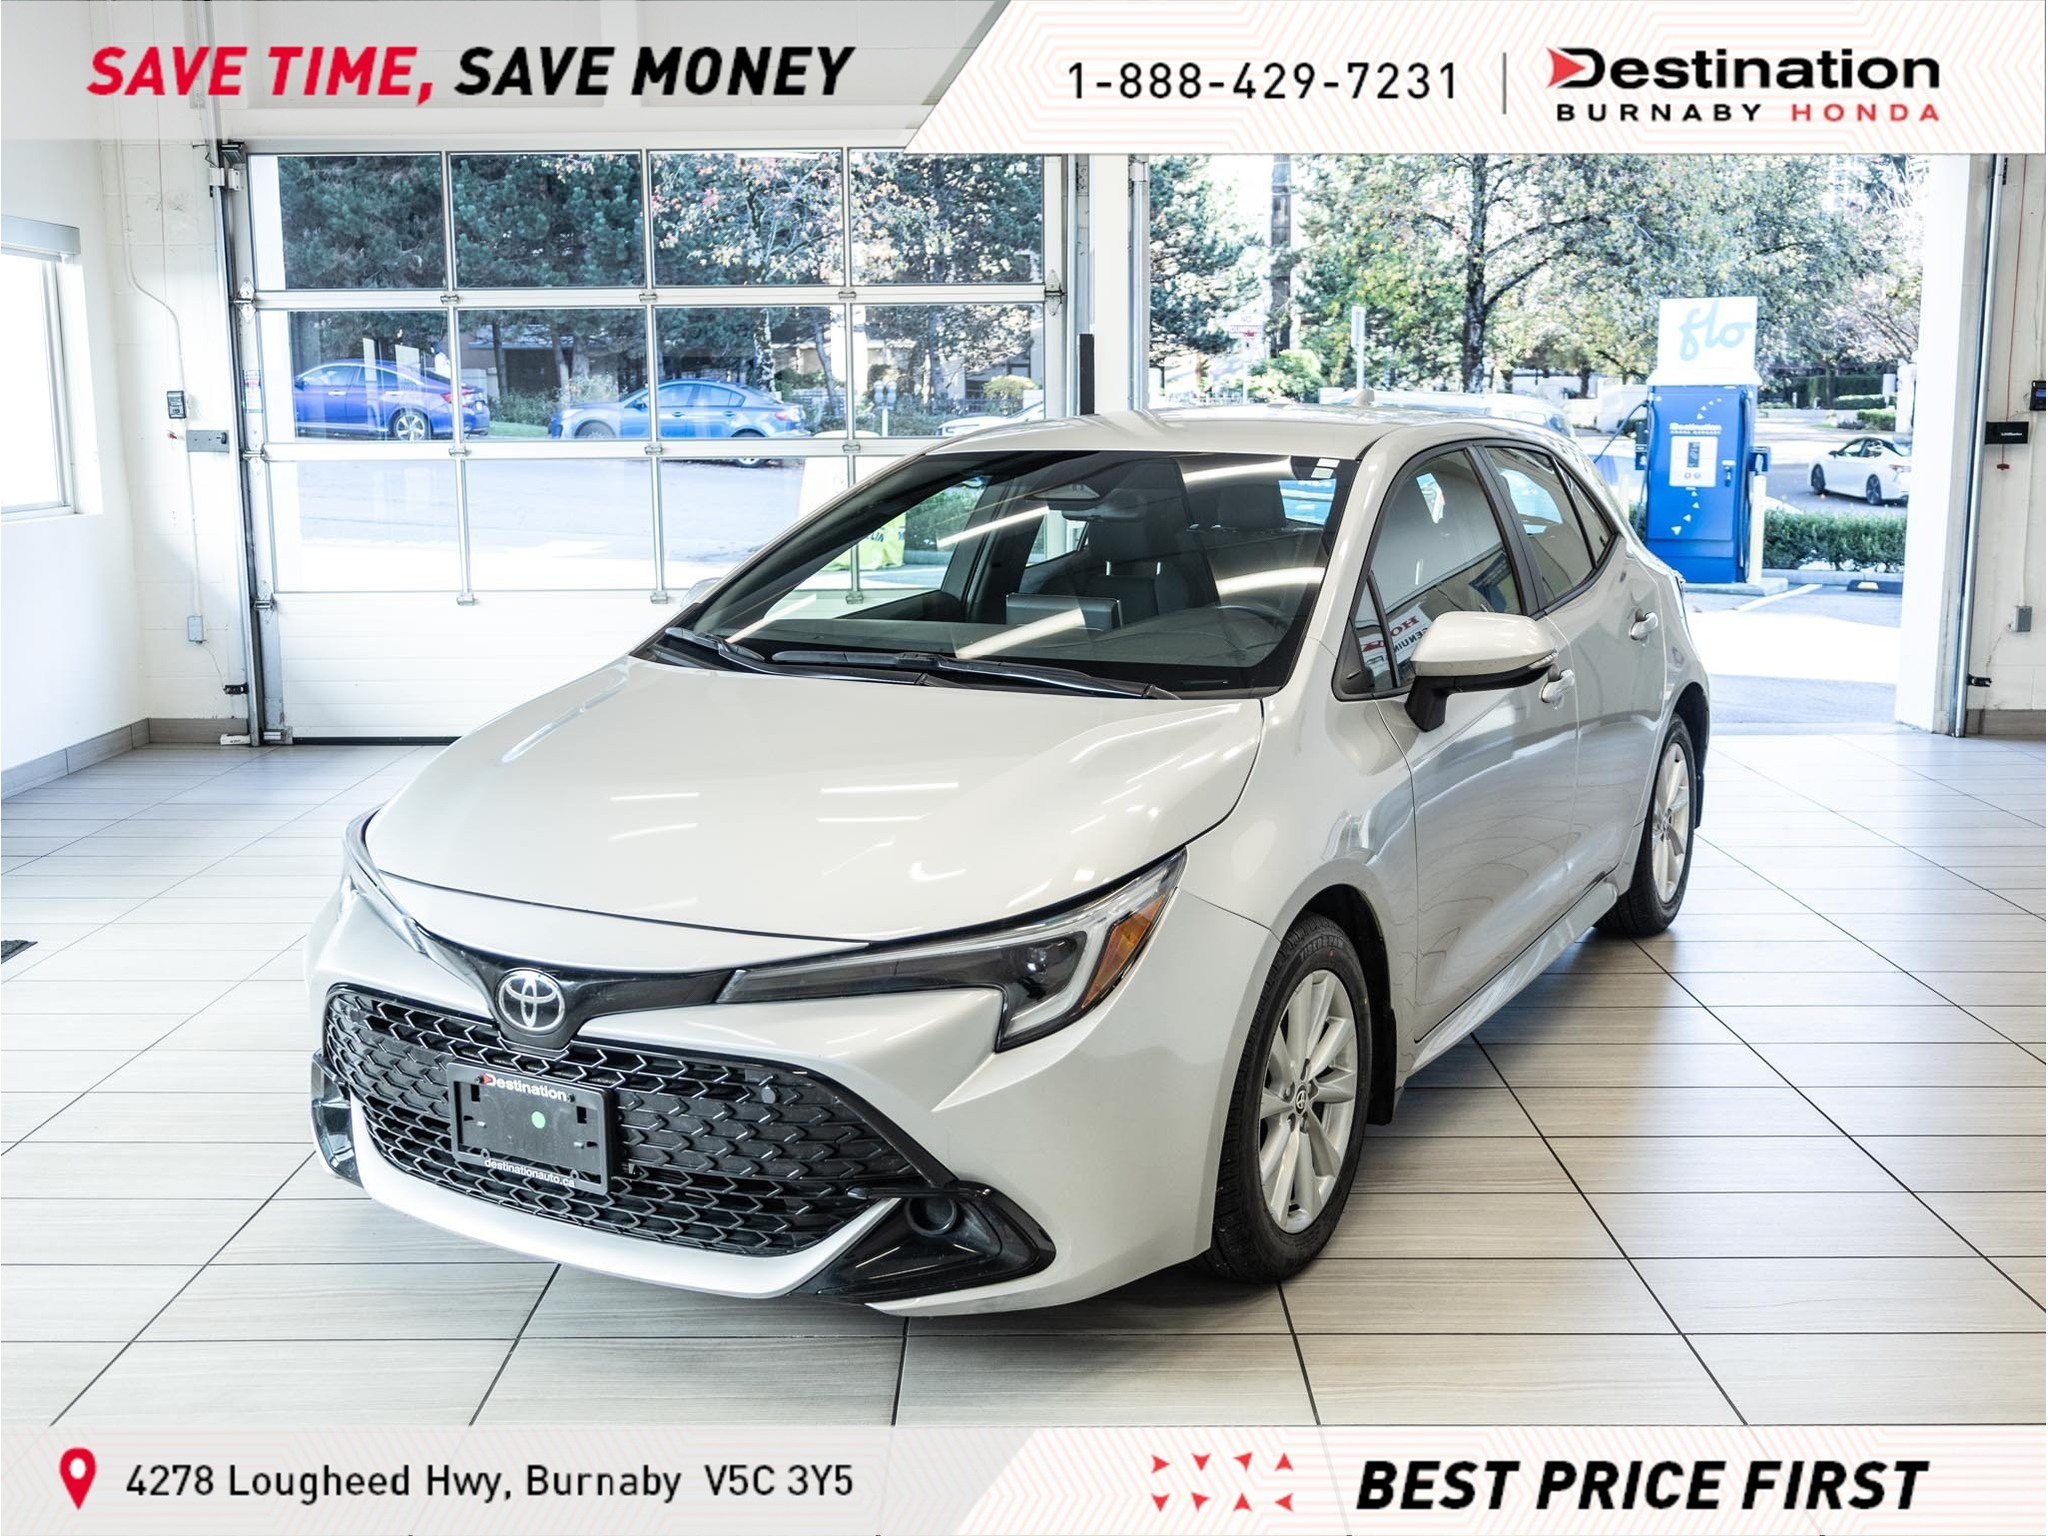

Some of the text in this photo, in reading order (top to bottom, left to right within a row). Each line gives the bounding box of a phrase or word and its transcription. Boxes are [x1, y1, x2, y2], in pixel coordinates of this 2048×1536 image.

[1679, 299, 1752, 362] flo
[482, 1073, 567, 1102] Destination
[484, 1158, 576, 1188] destinationauto.ca
